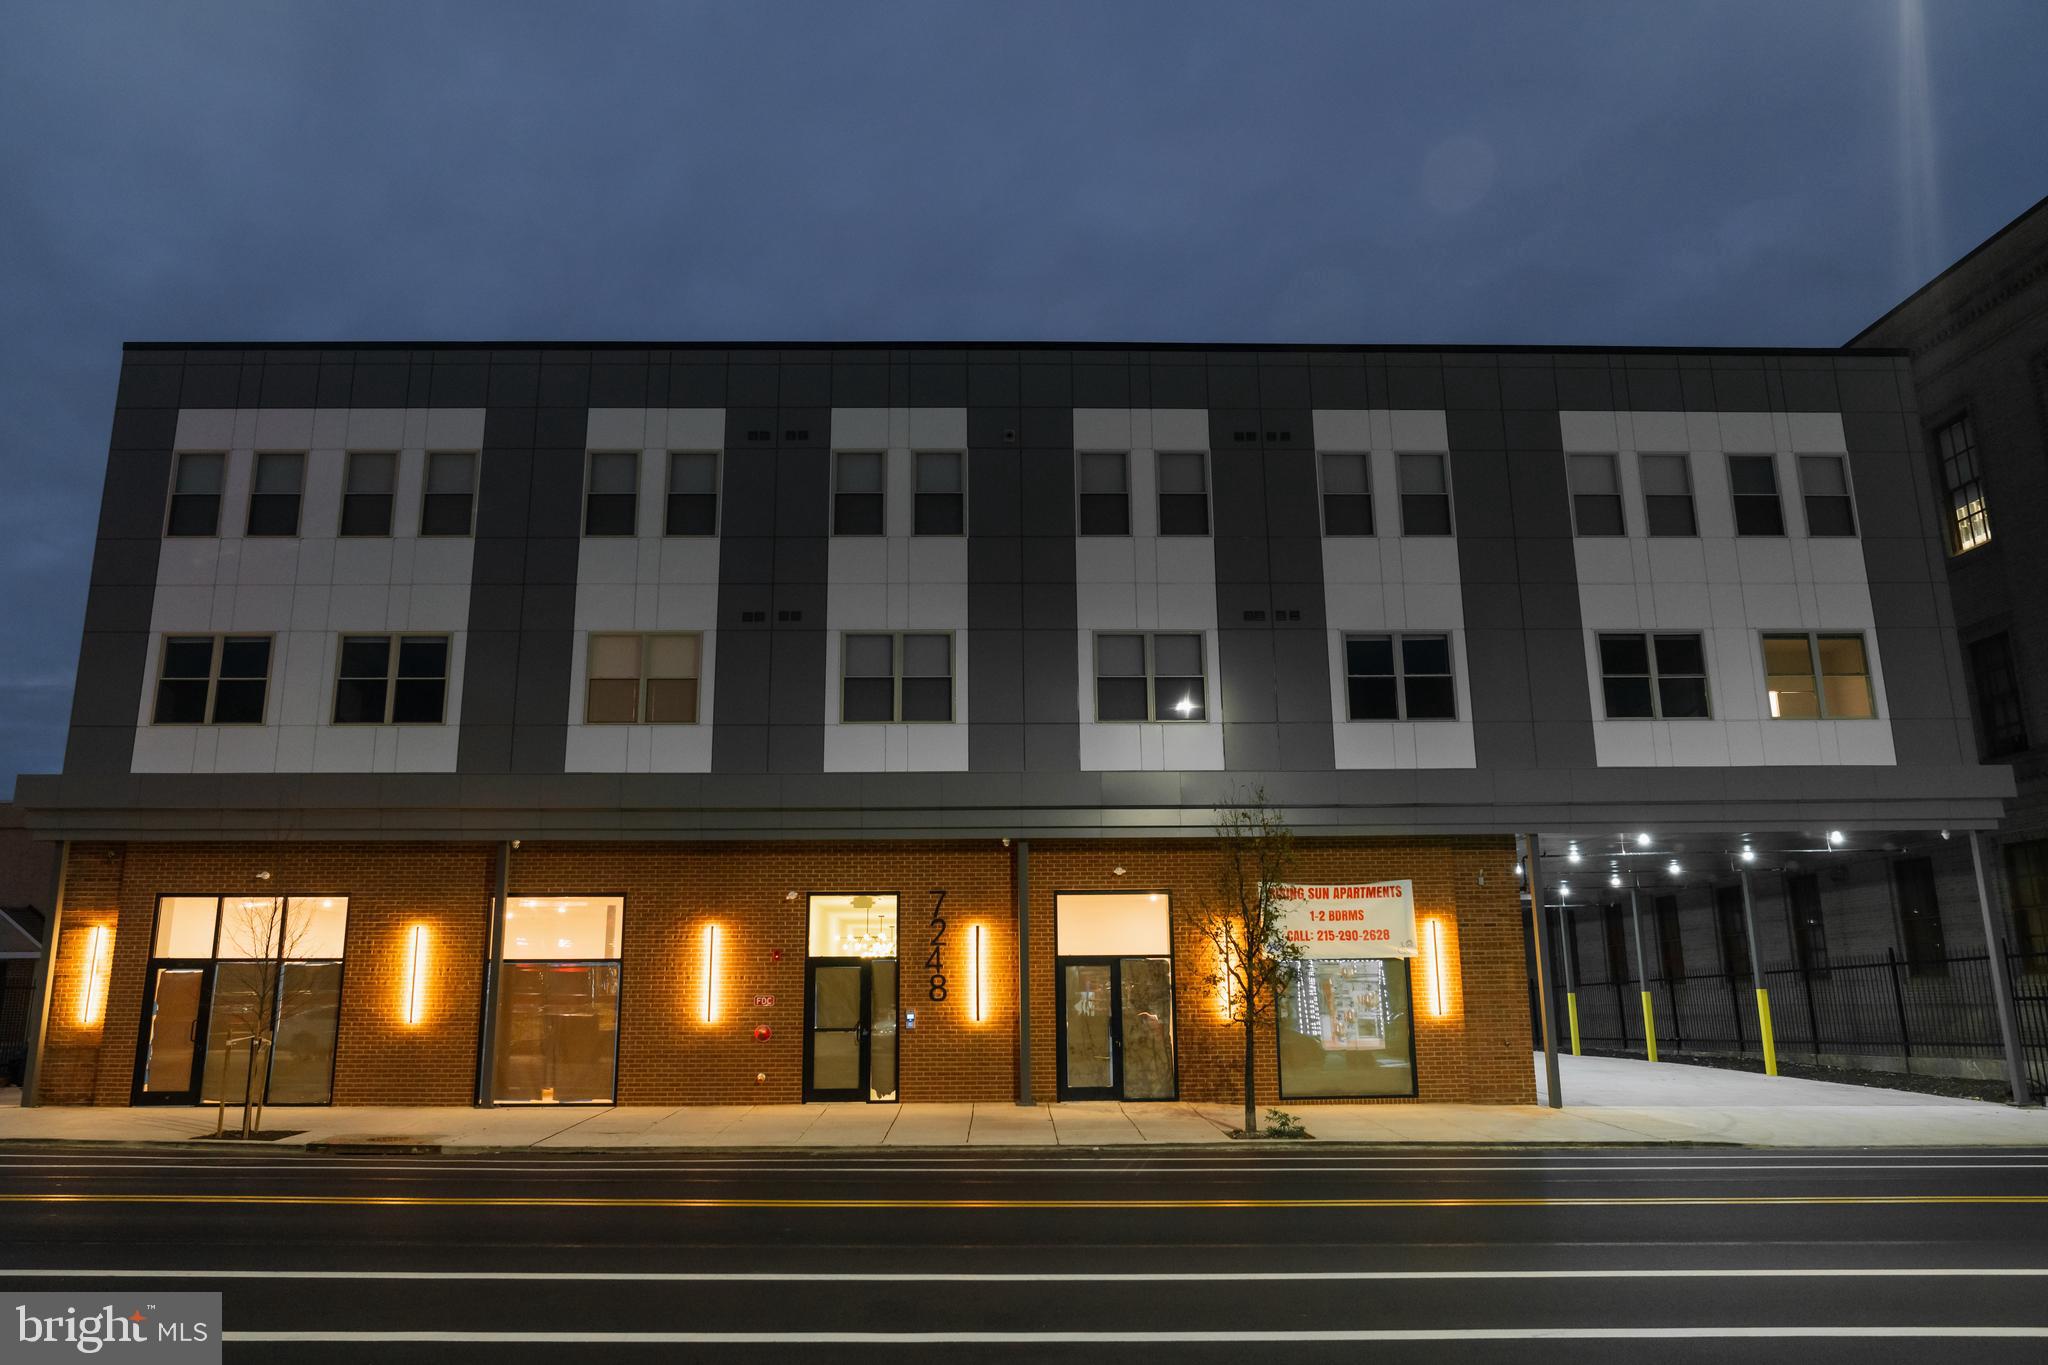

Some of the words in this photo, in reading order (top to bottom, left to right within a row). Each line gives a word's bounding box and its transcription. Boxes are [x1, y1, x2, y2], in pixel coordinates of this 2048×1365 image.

[1308, 887, 1329, 899] SUN
[1333, 885, 1402, 898] APARTMENTS
[1310, 910, 1325, 921] 1-2
[1329, 909, 1364, 921] BDRMS
[1287, 930, 1314, 942] CALL:
[1317, 929, 1390, 941] 215-290-2628
[926, 890, 947, 1002] 7248
[756, 997, 772, 1005] FDC
